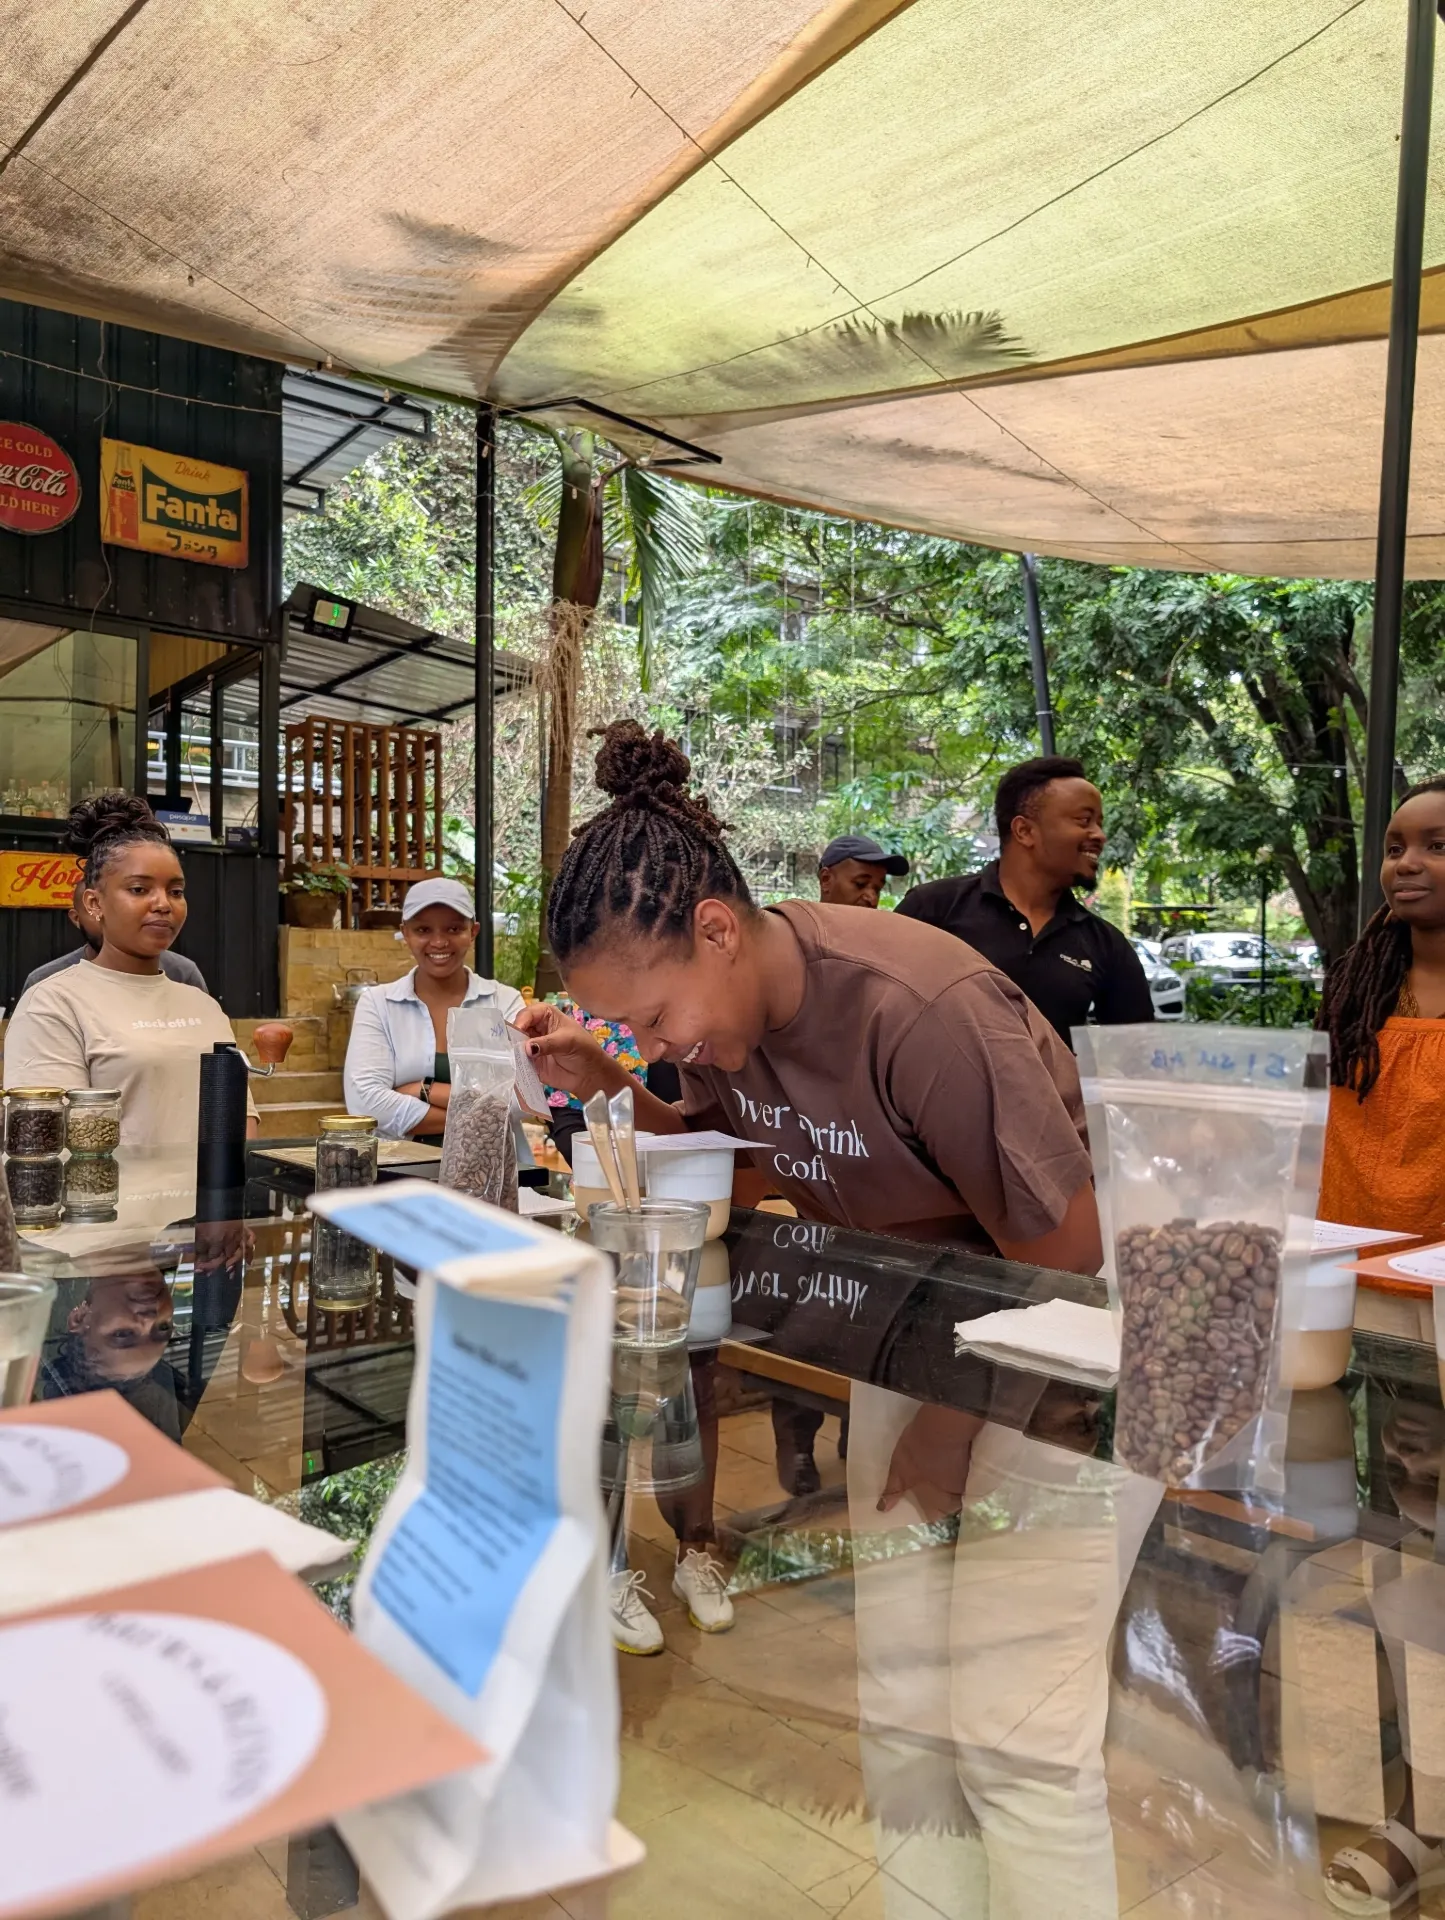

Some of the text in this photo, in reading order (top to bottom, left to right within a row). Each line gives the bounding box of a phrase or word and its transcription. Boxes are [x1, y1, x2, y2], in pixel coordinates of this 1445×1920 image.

[0, 438, 53, 458] E COLD
[174, 461, 210, 480] Drink
[21, 499, 60, 518] HERE
[146, 483, 238, 531] Fanta
[166, 531, 217, 559] ファンタ
